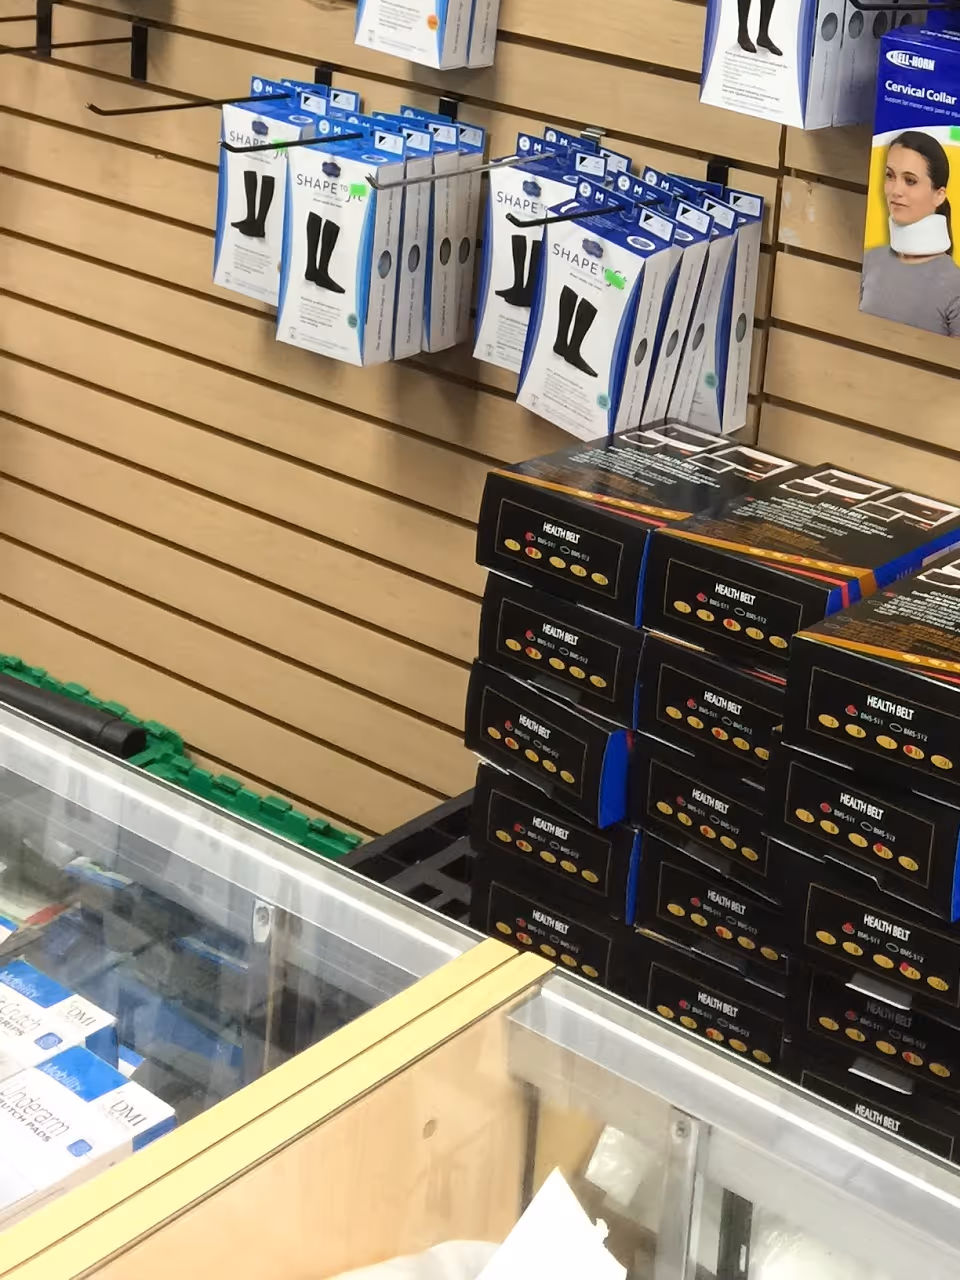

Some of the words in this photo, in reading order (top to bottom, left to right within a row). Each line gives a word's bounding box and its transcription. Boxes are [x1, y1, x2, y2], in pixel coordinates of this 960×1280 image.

[891, 52, 935, 71] BELL-HORN
[885, 80, 925, 99] Cervical
[926, 90, 957, 106] Collar
[296, 174, 338, 196] SHAPE
[552, 243, 598, 276] SHAPE
[542, 521, 566, 539] HEALTH
[565, 529, 581, 545] BELT
[714, 582, 739, 601] HEALTH
[739, 590, 756, 606] BELT
[542, 622, 564, 640] HEALTH
[564, 632, 580, 646] BELT
[704, 691, 727, 709] HEALTH
[727, 701, 743, 716] BELT
[866, 695, 896, 717] HEALTH
[895, 704, 916, 721] BELT
[840, 792, 867, 813] HEALTH
[866, 804, 885, 820] BELT
[863, 914, 892, 934] HEALTH
[892, 925, 911, 942] BELT
[66, 1006, 97, 1028] DMI
[41, 1062, 82, 1093] Mobility
[0, 1081, 70, 1137] Underarm
[110, 1099, 146, 1127] DMI
